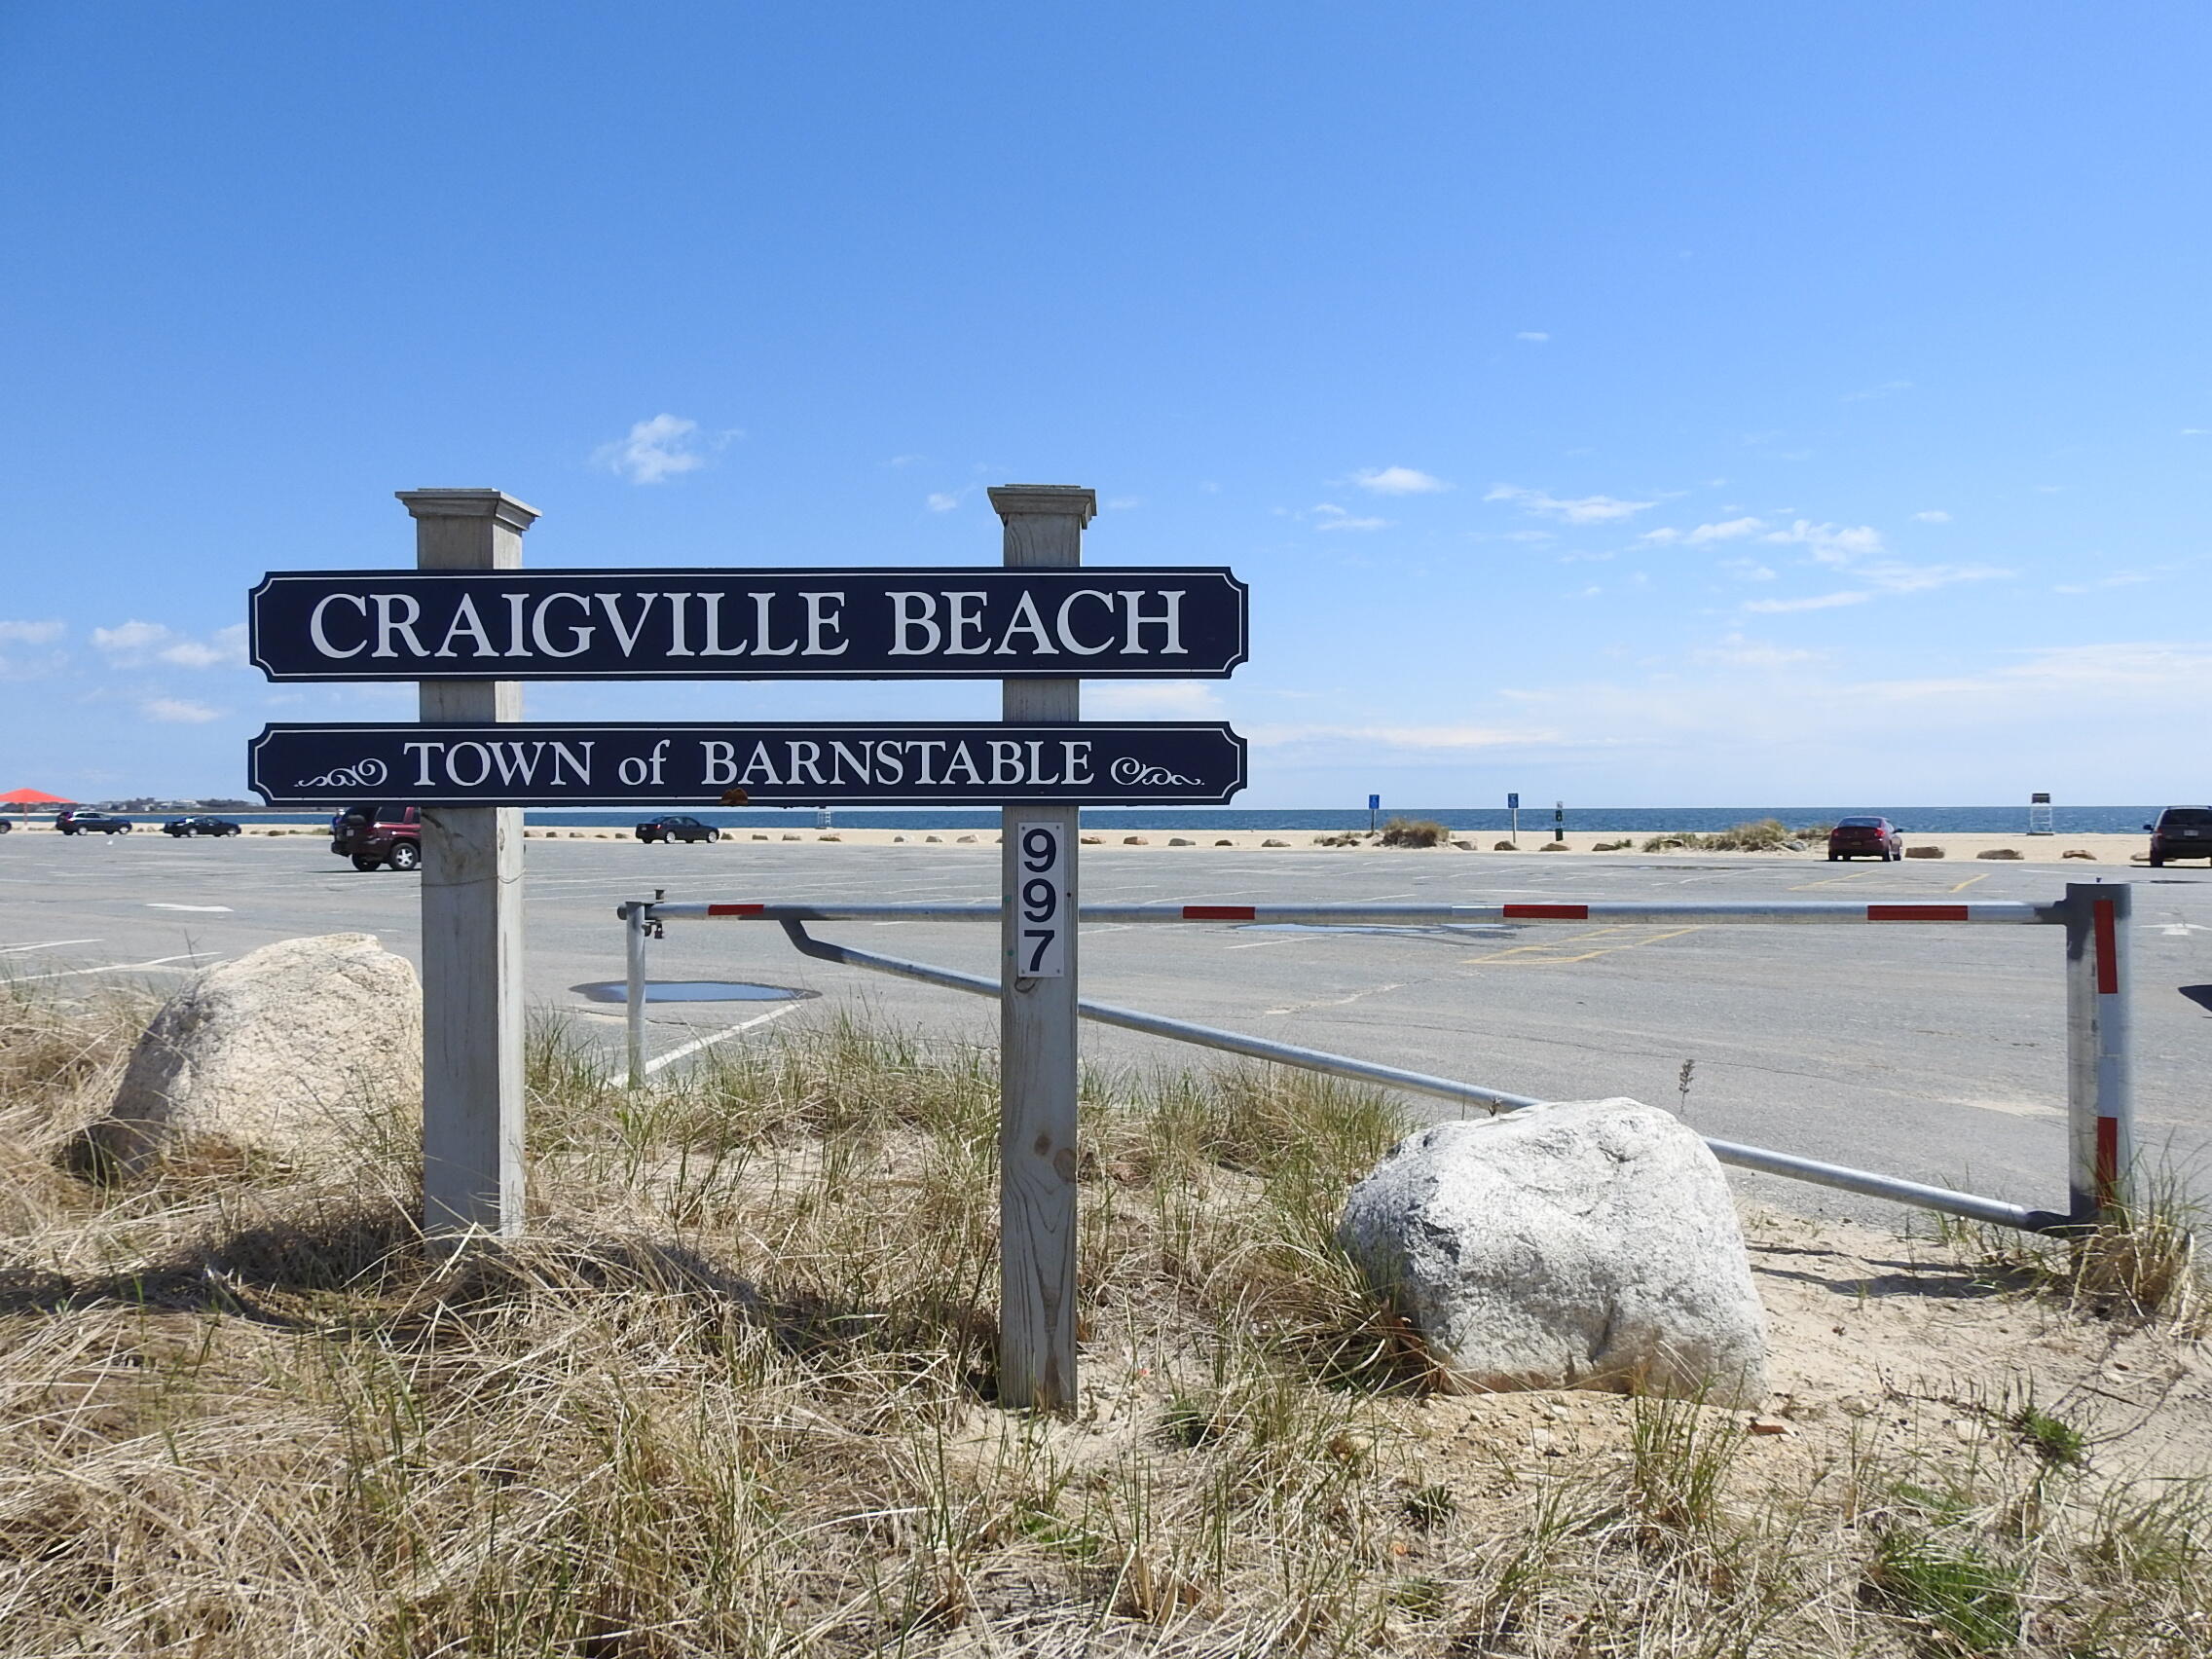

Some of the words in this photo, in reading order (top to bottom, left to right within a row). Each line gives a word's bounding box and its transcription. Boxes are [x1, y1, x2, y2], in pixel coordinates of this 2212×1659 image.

[311, 592, 850, 658] CRAIGVILLE
[884, 590, 1189, 655] BEACH
[403, 741, 595, 787] TOWN
[618, 739, 671, 786] of
[699, 740, 1094, 786] BARNSTABLE
[1022, 828, 1057, 973] 997
